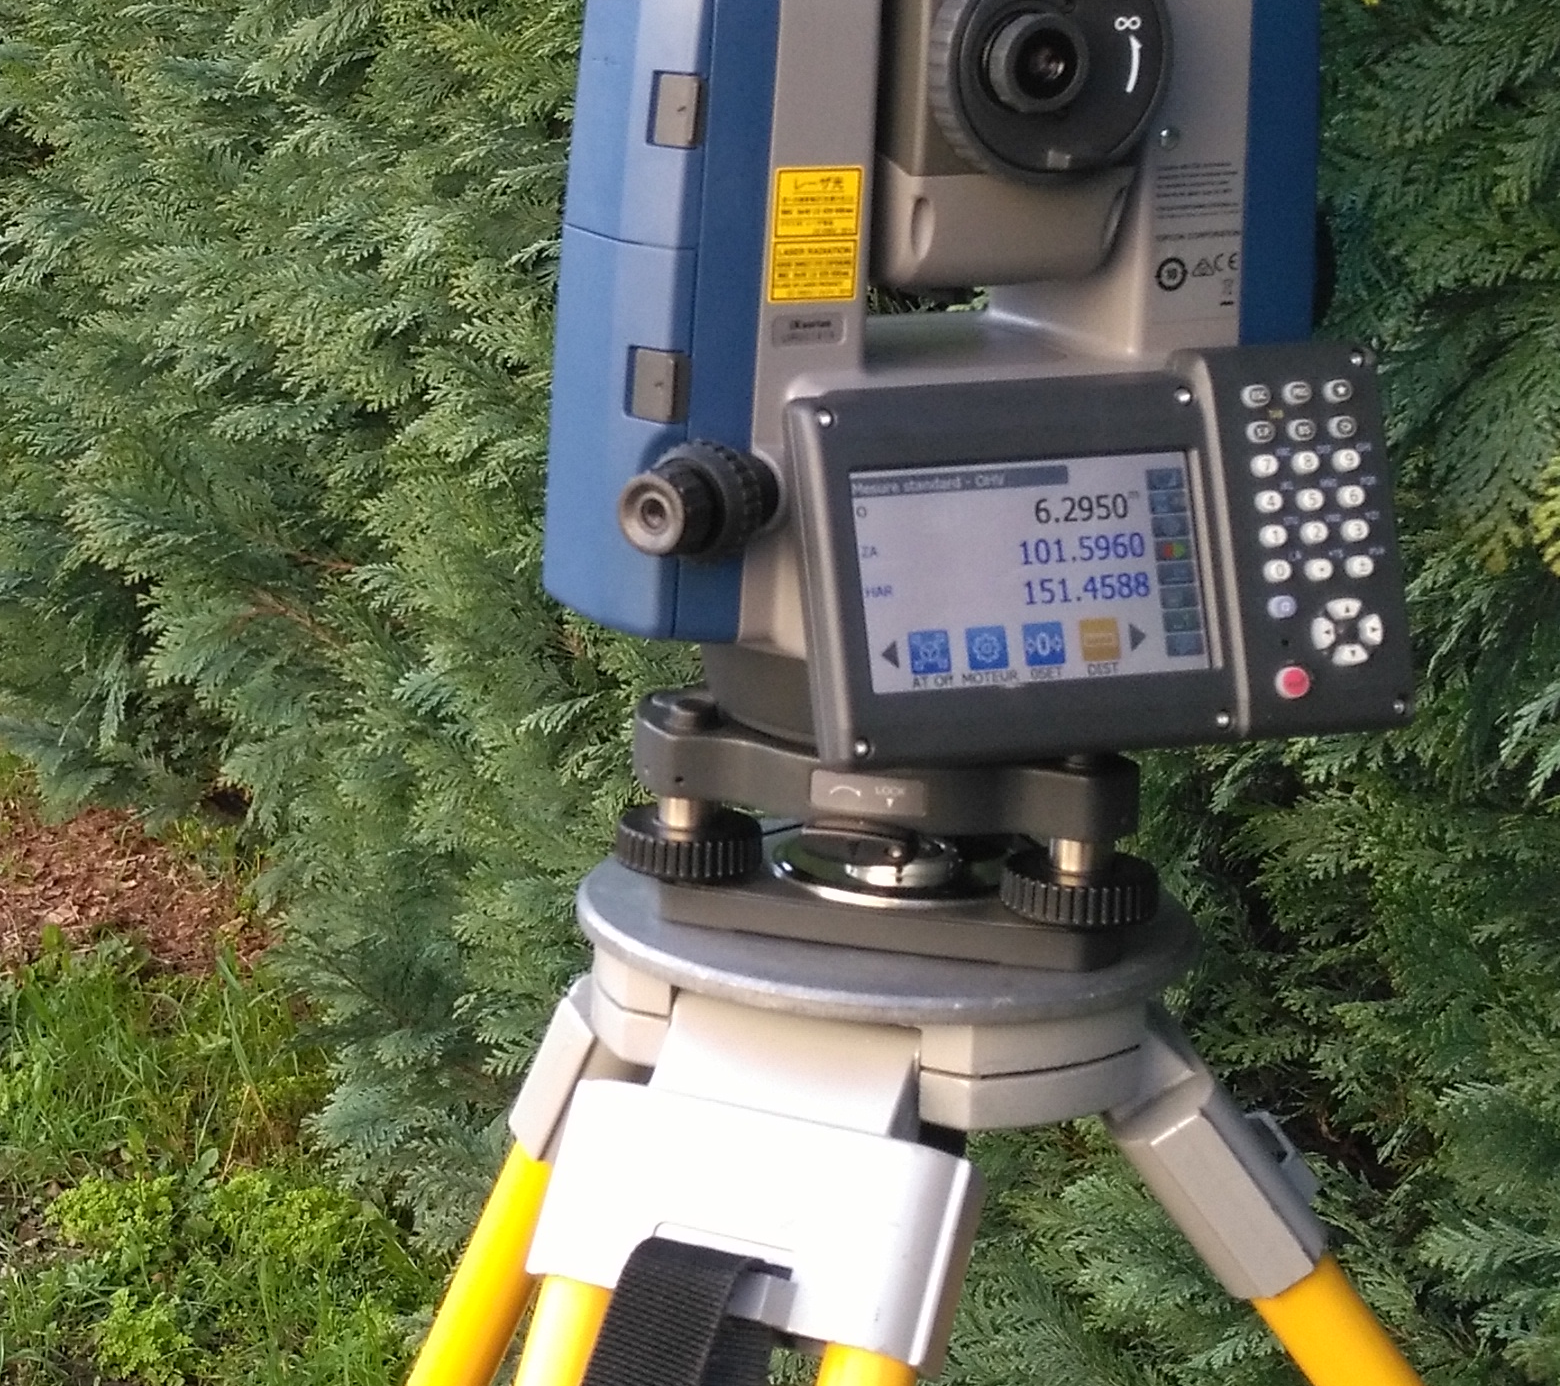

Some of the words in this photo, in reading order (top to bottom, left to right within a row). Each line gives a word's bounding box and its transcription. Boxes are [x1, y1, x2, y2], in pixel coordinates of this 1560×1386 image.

[1261, 458, 1271, 471] 7
[1304, 455, 1312, 469] 8
[1345, 452, 1354, 465] 9
[1266, 495, 1275, 507] 4
[1309, 493, 1317, 506] 5
[1349, 489, 1358, 503] 6
[1034, 493, 1129, 525] 6.2950
[1313, 524, 1322, 538] 2
[1354, 522, 1363, 536] 3
[1018, 531, 1146, 565] 101.5960
[1276, 564, 1285, 577] 0
[864, 584, 892, 599] HAR
[1023, 571, 1150, 606] 151.4588
[1087, 662, 1119, 676] DIST
[912, 676, 929, 689] AT
[961, 670, 1018, 686] MOTEUR
